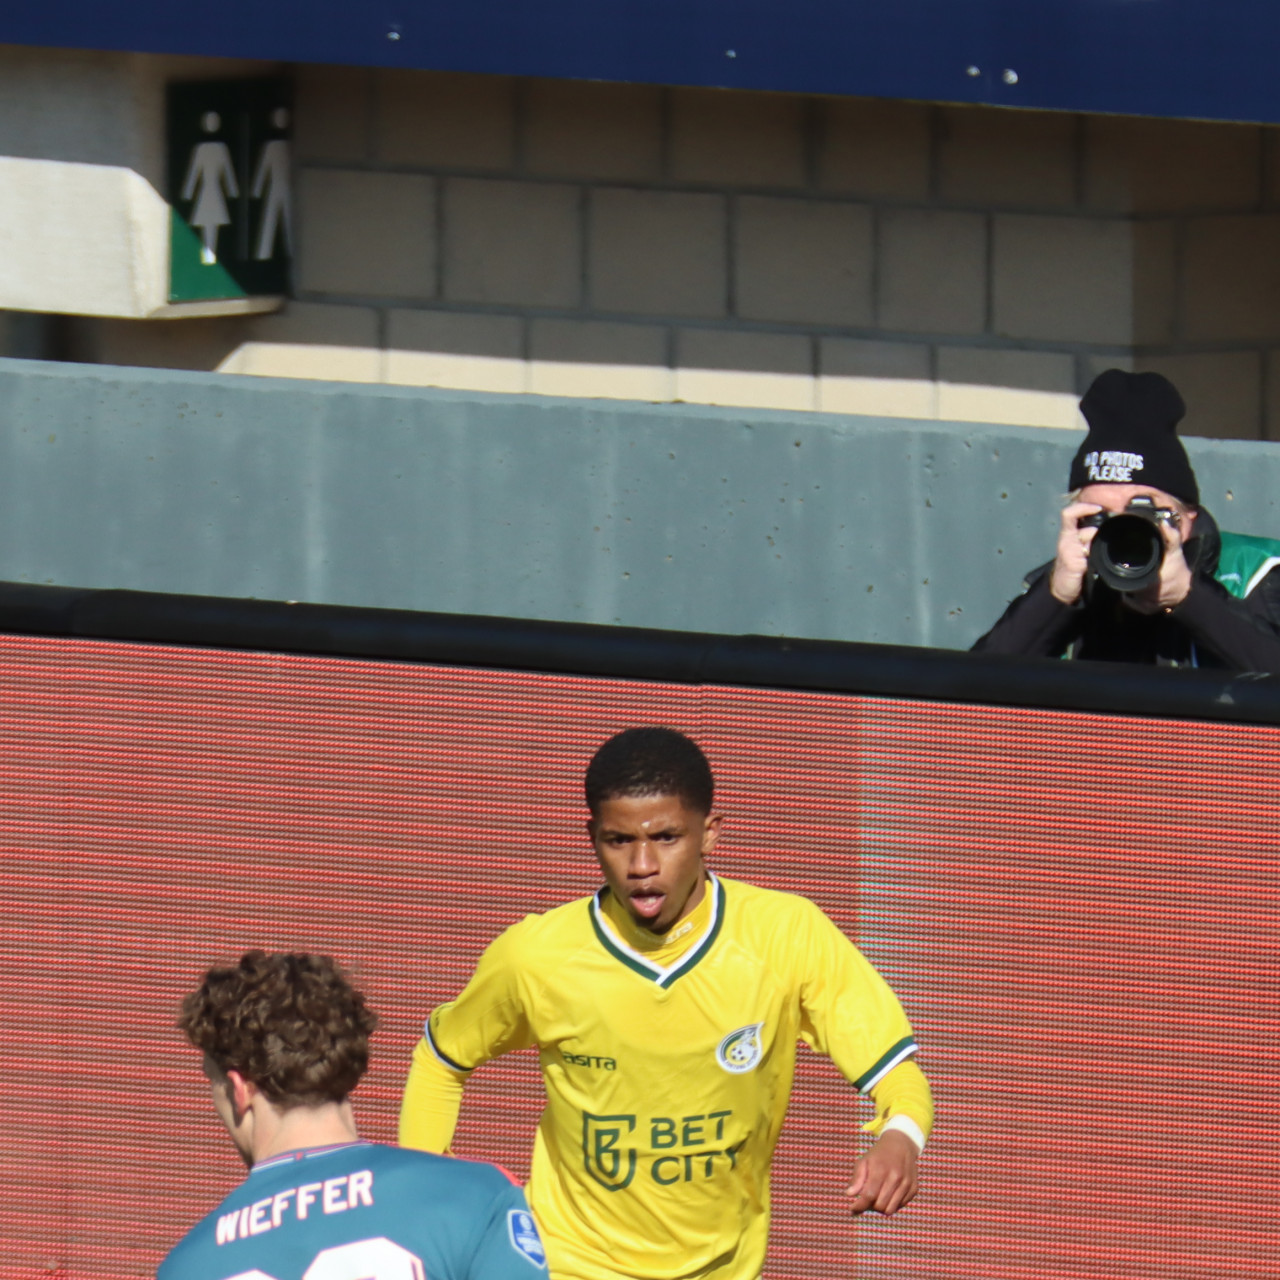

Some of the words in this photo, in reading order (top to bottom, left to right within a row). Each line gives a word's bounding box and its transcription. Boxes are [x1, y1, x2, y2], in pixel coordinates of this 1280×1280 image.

[1089, 466, 1133, 482] PLEASE
[1100, 451, 1144, 470] PHOTOS
[650, 1109, 733, 1149] BET
[650, 1146, 738, 1186] CITY
[216, 1169, 375, 1246] WIEFFER
